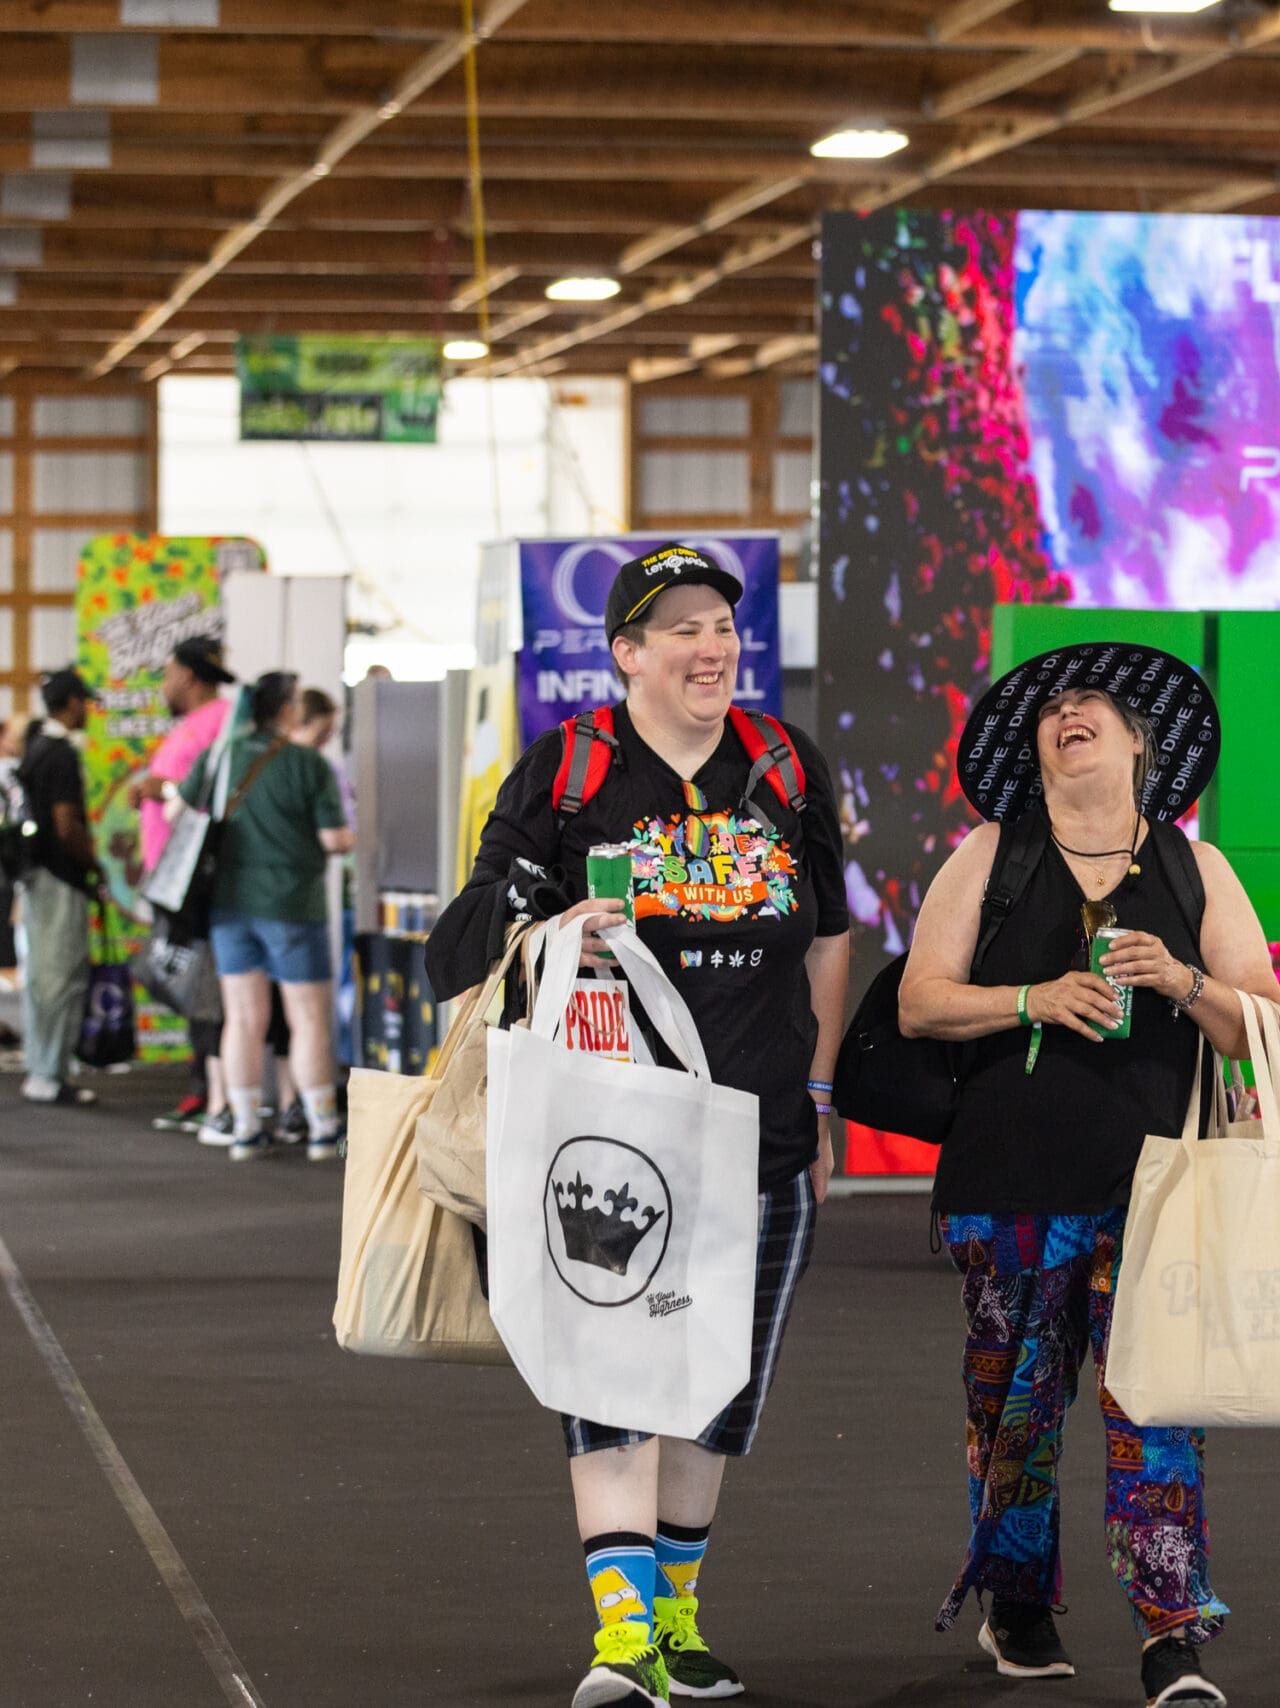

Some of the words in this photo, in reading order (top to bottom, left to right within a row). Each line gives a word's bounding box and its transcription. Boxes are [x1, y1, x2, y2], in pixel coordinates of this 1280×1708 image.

[1150, 674, 1184, 715] DIME
[969, 714, 1000, 758] DIME
[977, 747, 1009, 790] DIME
[1008, 685, 1041, 727] DIME
[1161, 707, 1194, 752] DIME
[1171, 744, 1204, 791] DIME
[663, 855, 762, 884] SAFE
[683, 887, 725, 902] WITH
[733, 888, 754, 902] US
[565, 991, 629, 1052] PRIDE
